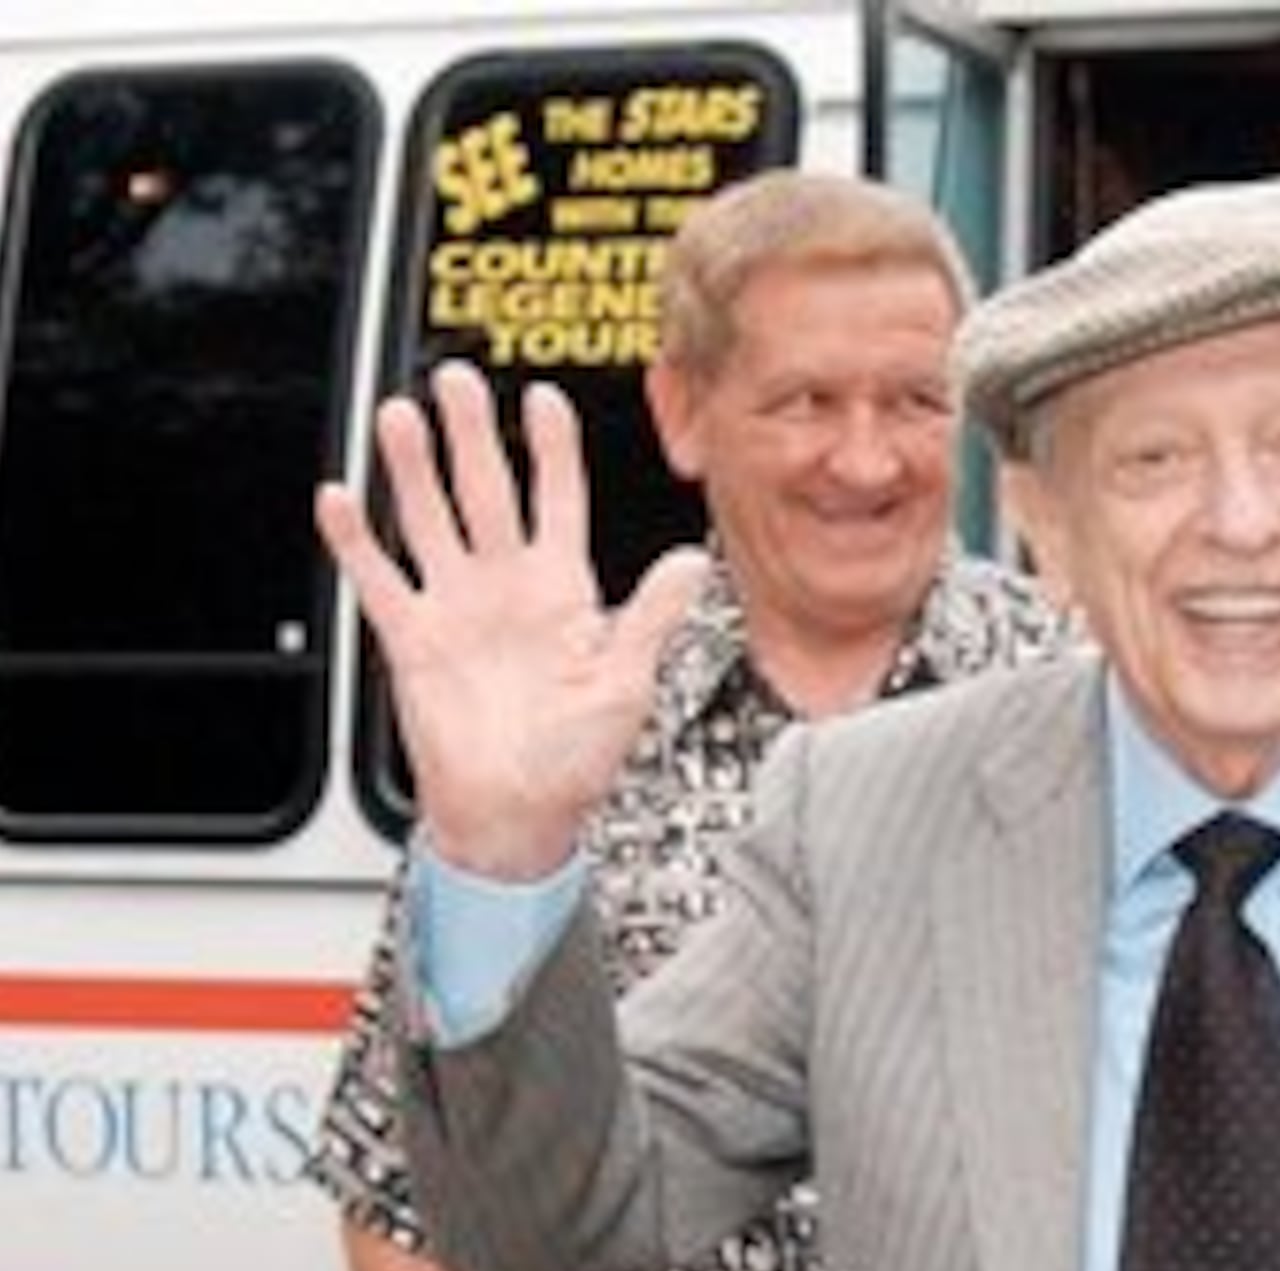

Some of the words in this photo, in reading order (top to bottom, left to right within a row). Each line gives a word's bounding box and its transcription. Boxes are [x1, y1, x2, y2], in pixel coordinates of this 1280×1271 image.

[542, 97, 614, 143] THE
[619, 85, 762, 143] STARS
[432, 111, 539, 234] SEE
[569, 145, 715, 190] HOMES
